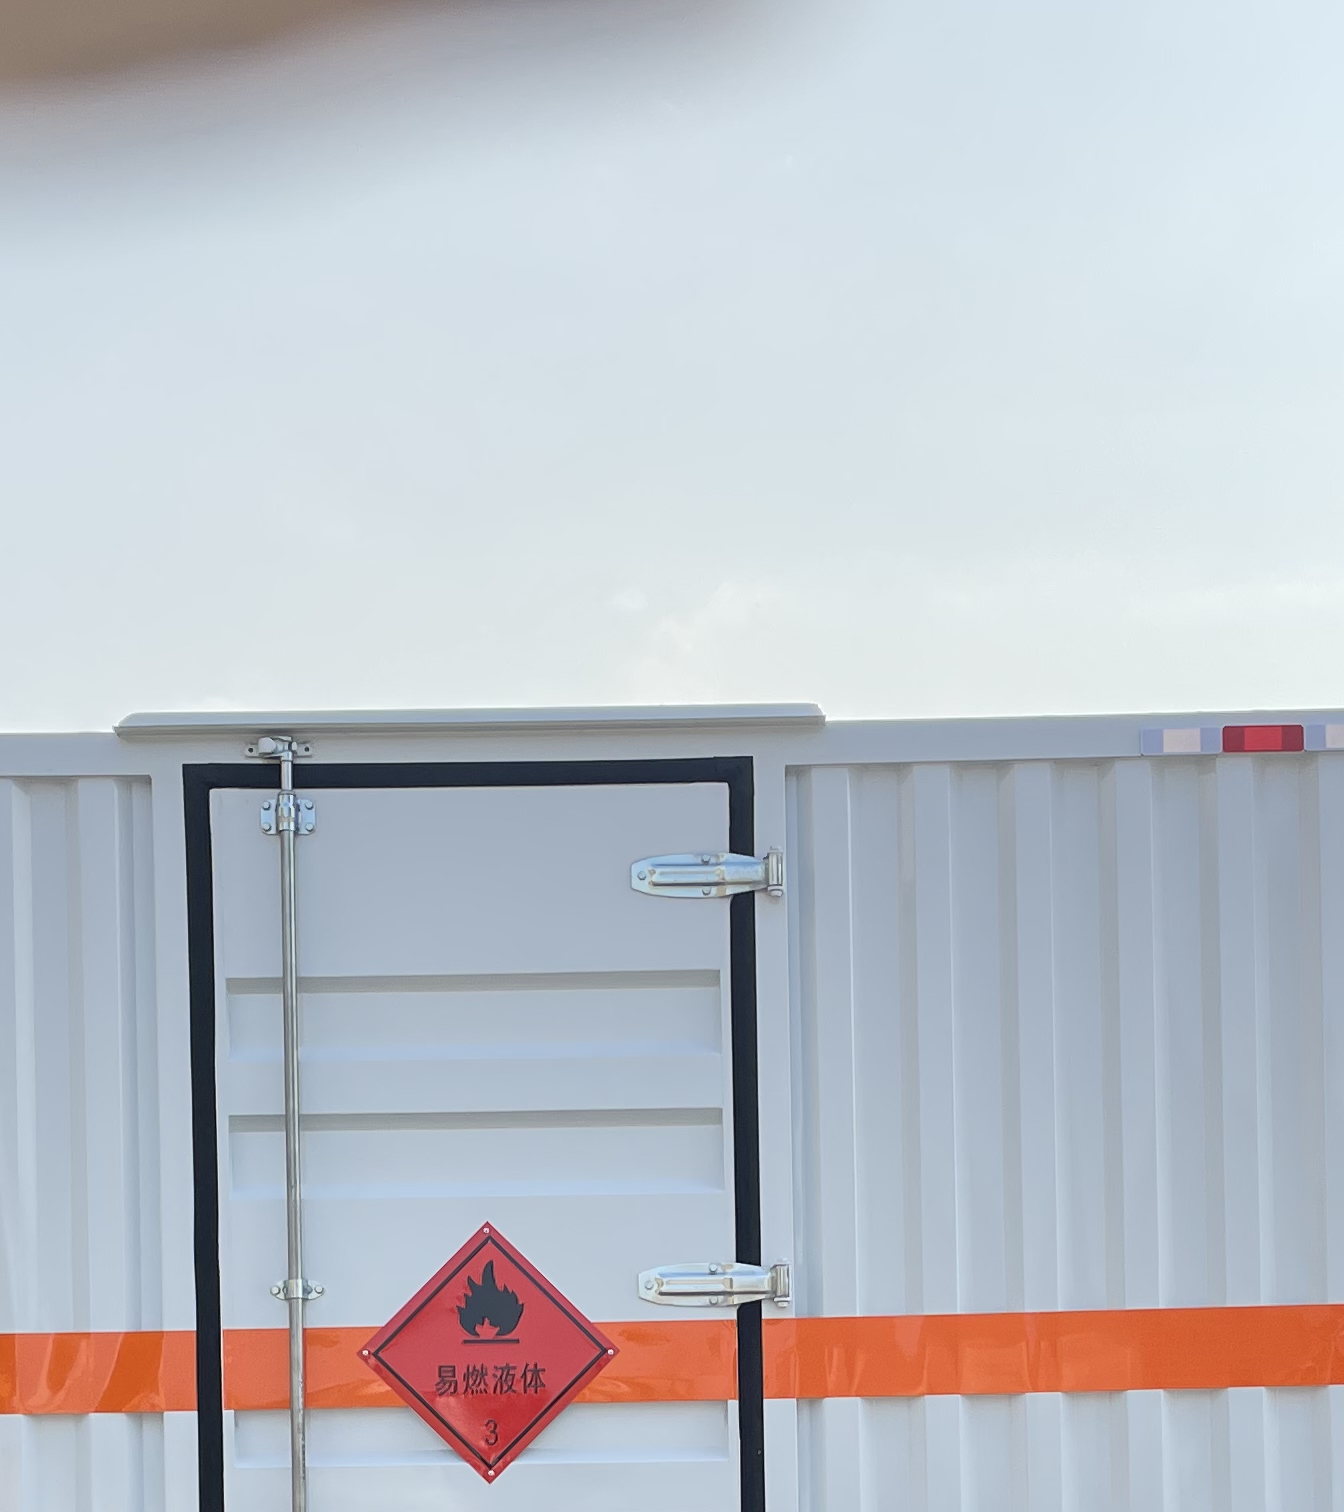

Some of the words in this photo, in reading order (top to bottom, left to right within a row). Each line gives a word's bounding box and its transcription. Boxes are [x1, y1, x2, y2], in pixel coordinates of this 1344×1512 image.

[435, 1362, 546, 1396] 易燃液体
[484, 1419, 499, 1447] 3
